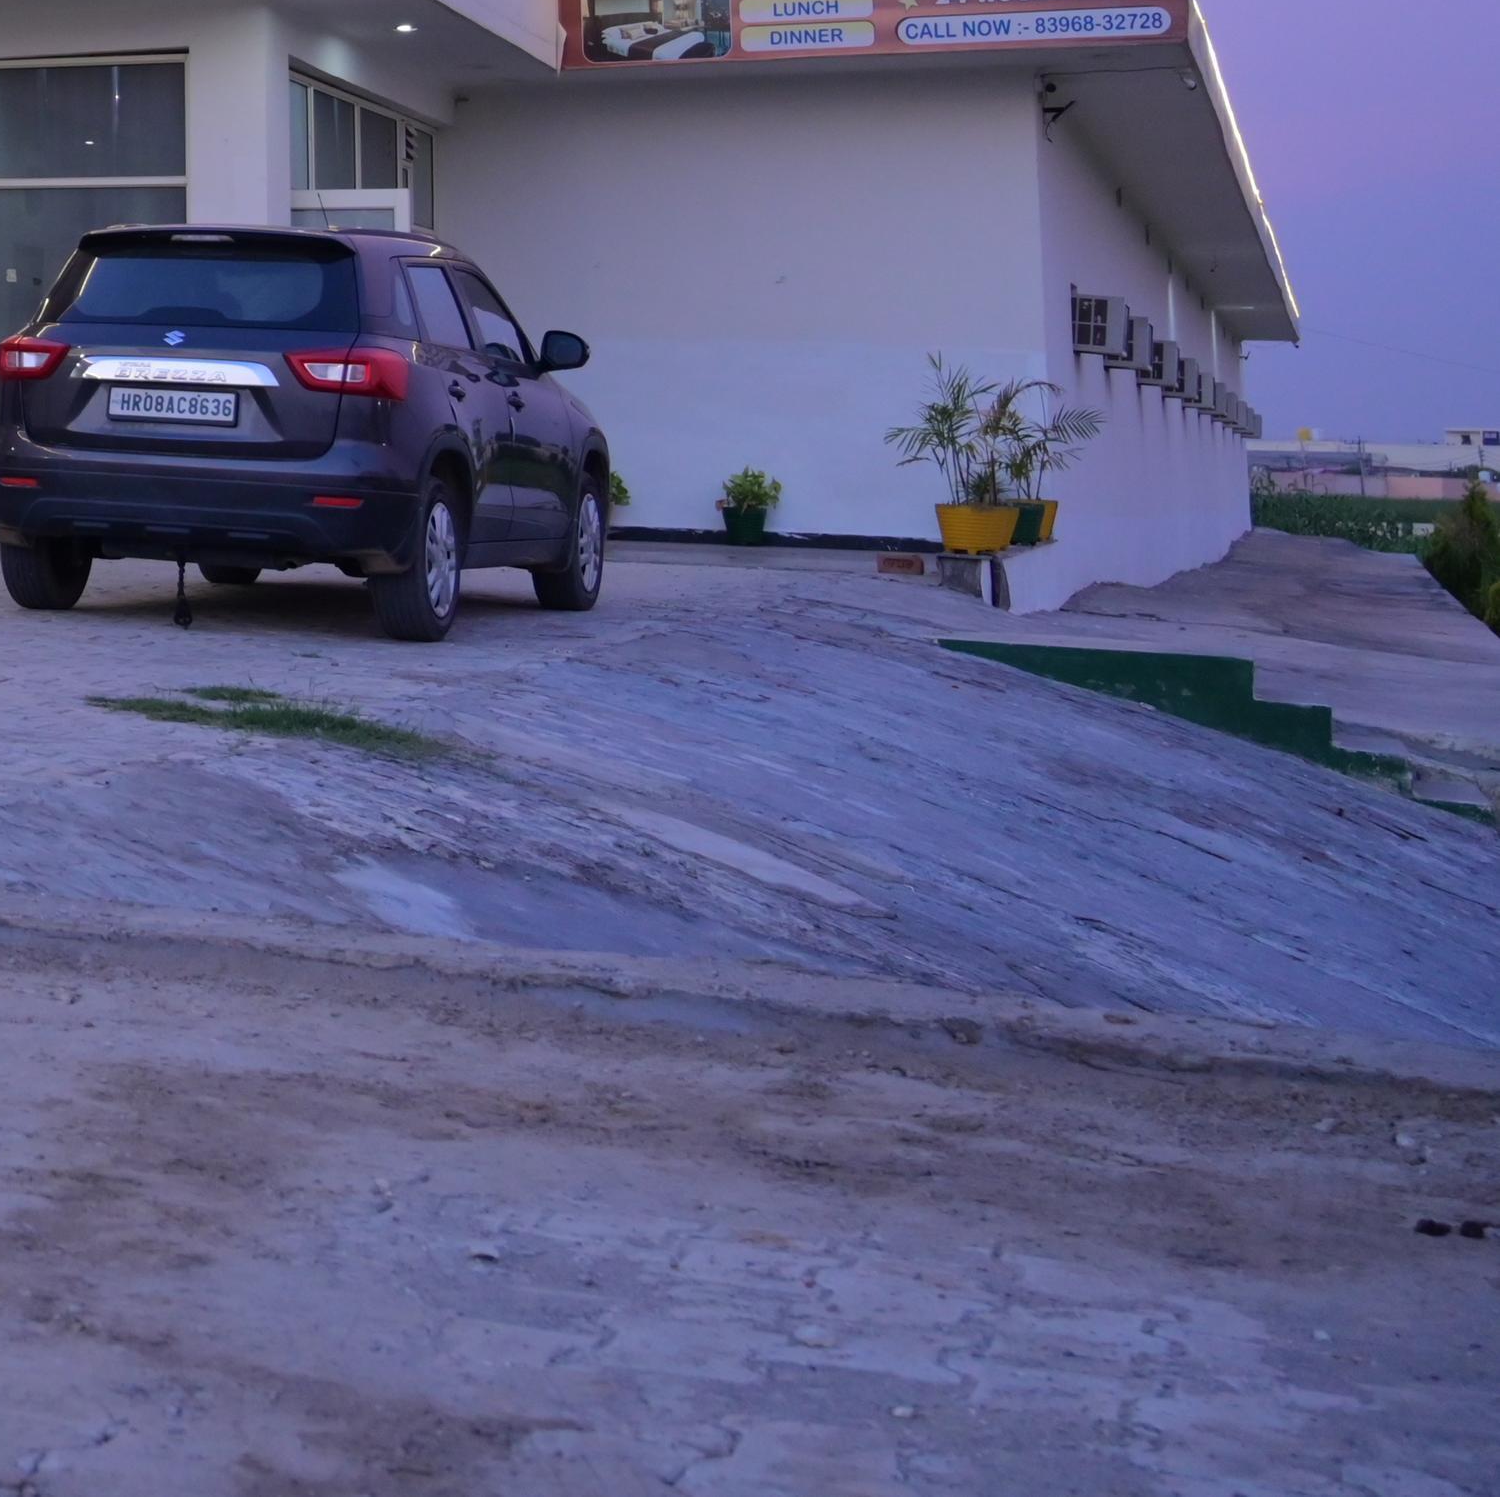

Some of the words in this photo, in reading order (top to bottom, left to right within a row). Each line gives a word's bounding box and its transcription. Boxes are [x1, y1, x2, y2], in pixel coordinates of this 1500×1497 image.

[772, 0, 840, 17] LUNCH
[904, 21, 957, 40] CALL
[962, 19, 1012, 37] NOW
[1035, 12, 1164, 34] 83968-32728
[769, 28, 844, 45] DINNER
[114, 367, 227, 382] BREZZA
[120, 392, 233, 417] HR08AC8636
